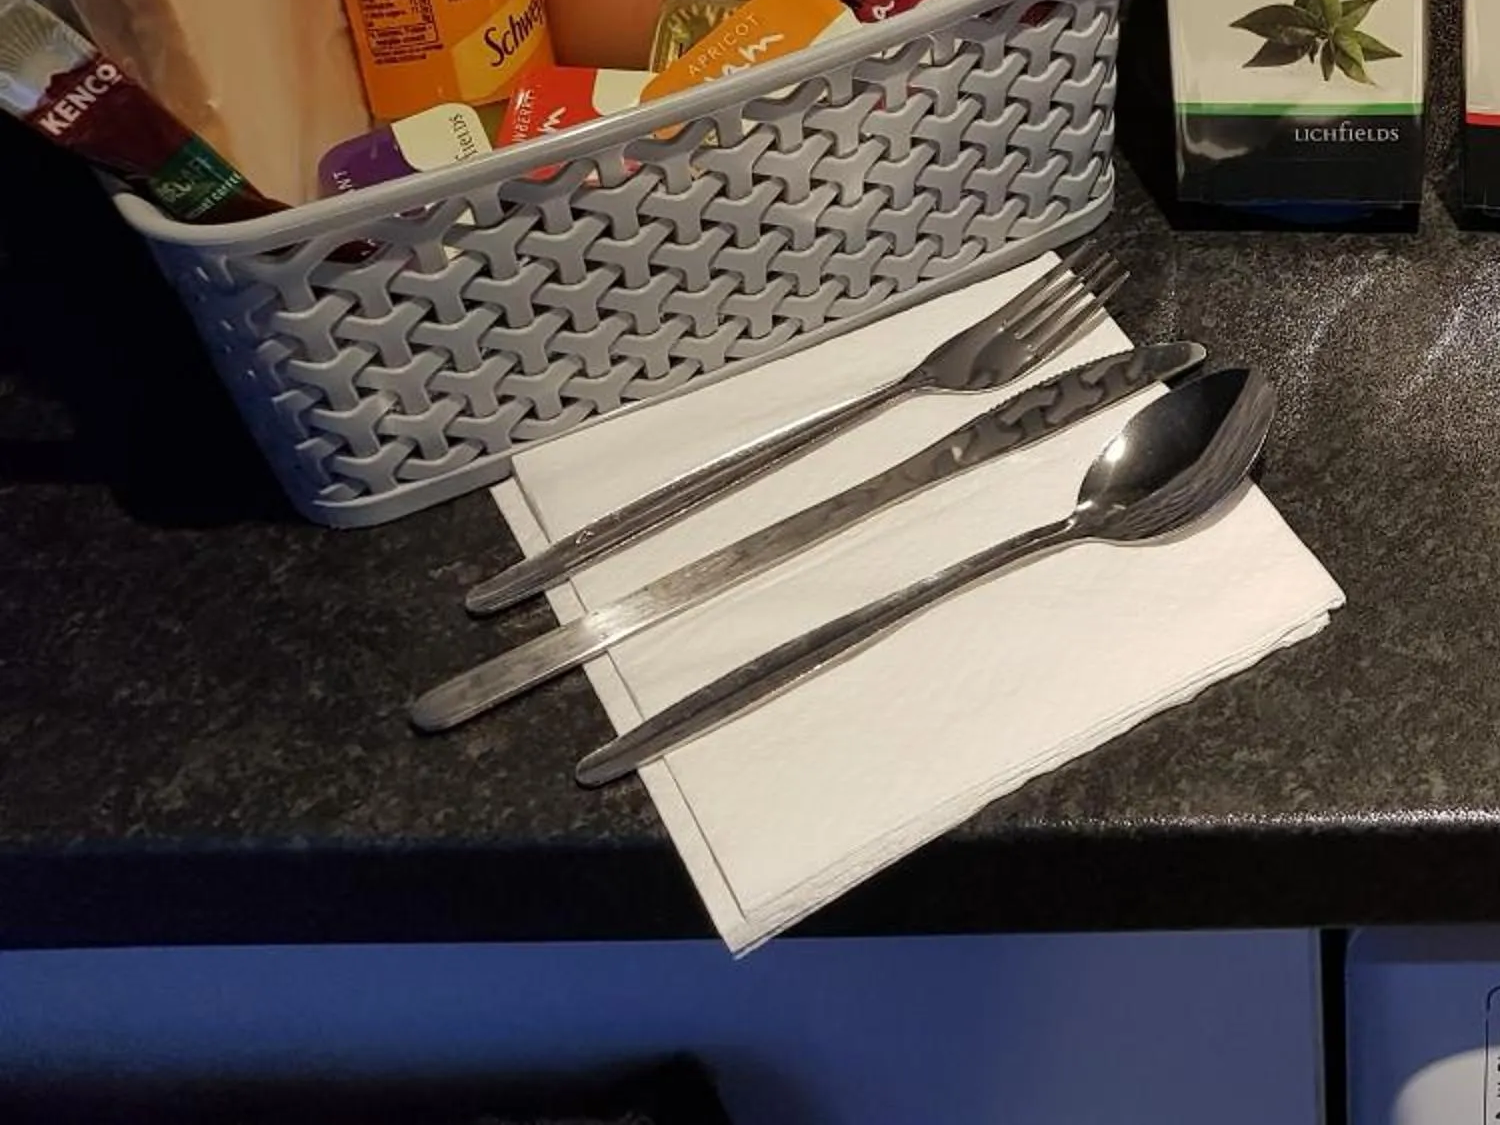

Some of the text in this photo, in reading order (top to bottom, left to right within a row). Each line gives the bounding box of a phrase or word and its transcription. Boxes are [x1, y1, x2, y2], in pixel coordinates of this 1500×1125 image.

[688, 14, 761, 77] APRICOT
[703, 32, 785, 83] am
[38, 63, 123, 136] KENCO
